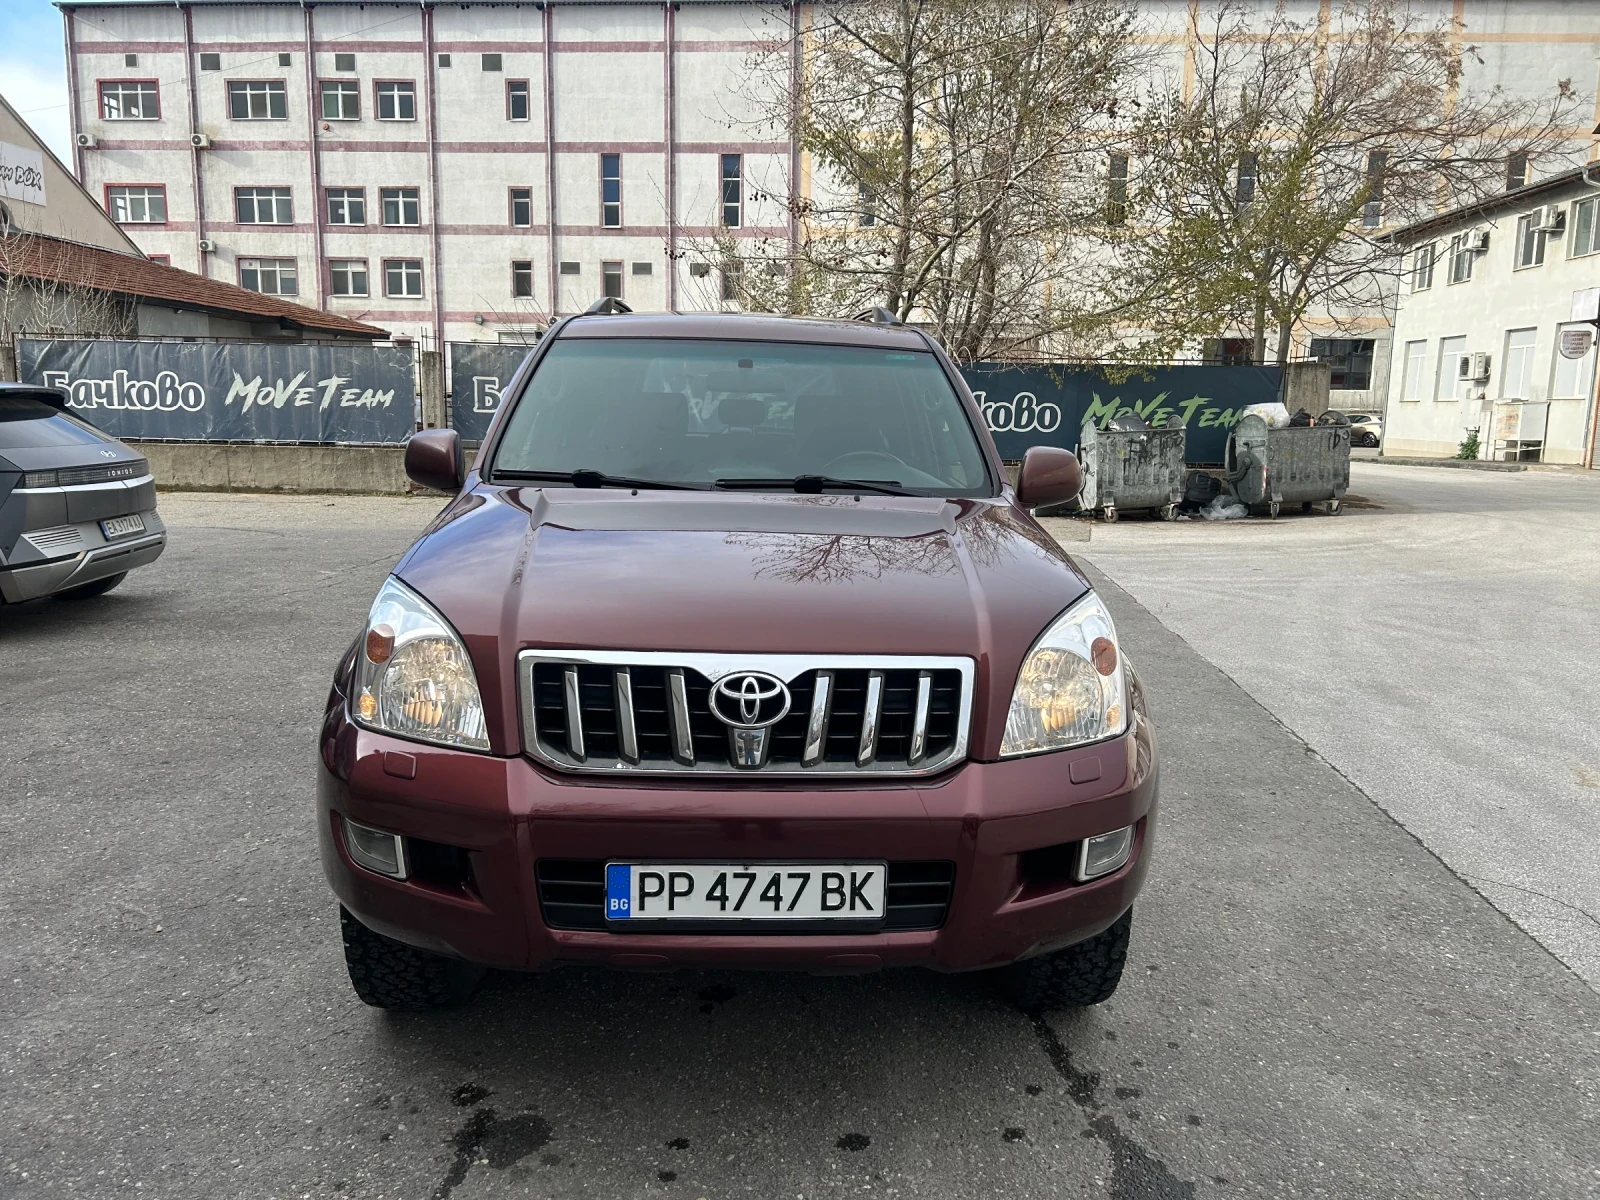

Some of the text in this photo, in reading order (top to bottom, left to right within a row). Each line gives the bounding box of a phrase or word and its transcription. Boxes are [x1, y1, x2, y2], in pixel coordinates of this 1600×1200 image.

[15, 165, 42, 191] BOX
[43, 370, 206, 411] Бачково
[972, 391, 1062, 433] ково
[610, 871, 875, 911] BG PP 4747 BK
